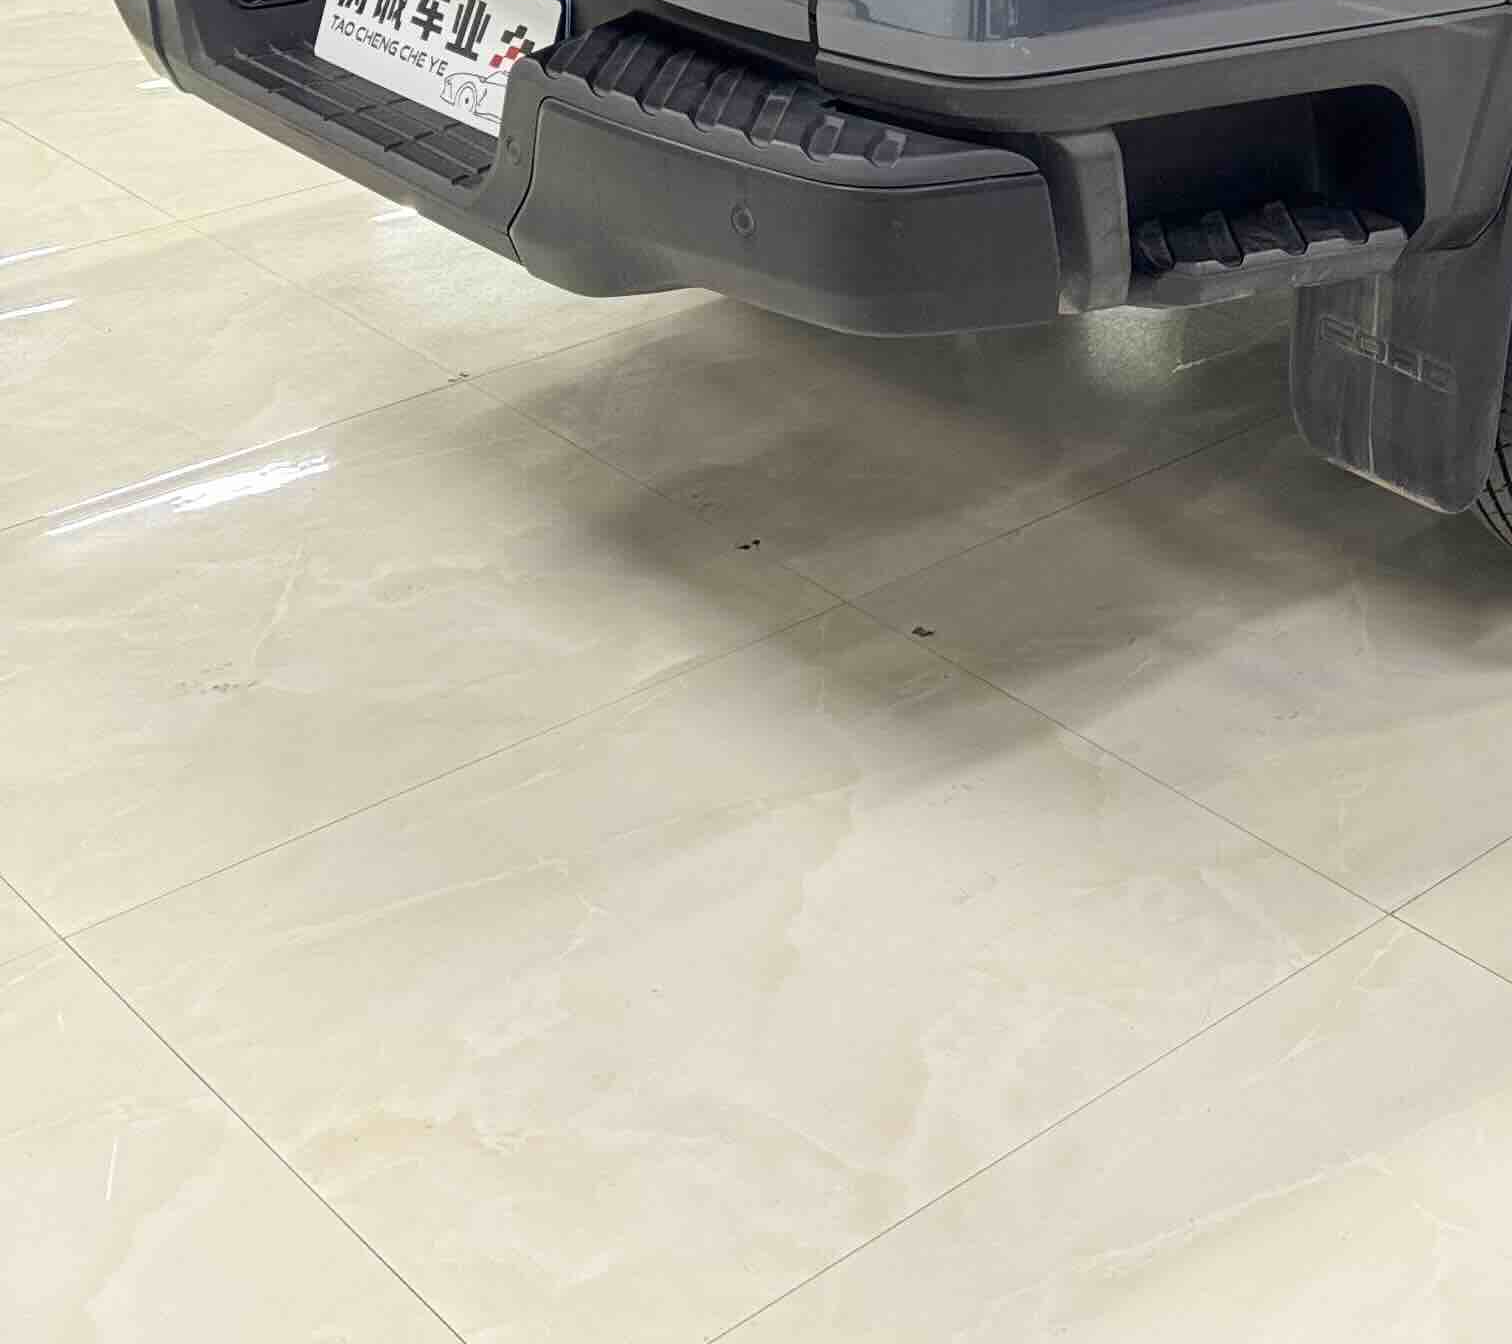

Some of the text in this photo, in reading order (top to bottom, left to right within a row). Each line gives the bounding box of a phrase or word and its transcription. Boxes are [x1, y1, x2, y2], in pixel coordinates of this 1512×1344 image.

[329, 13, 449, 77] TAO CHENG CHE YE
